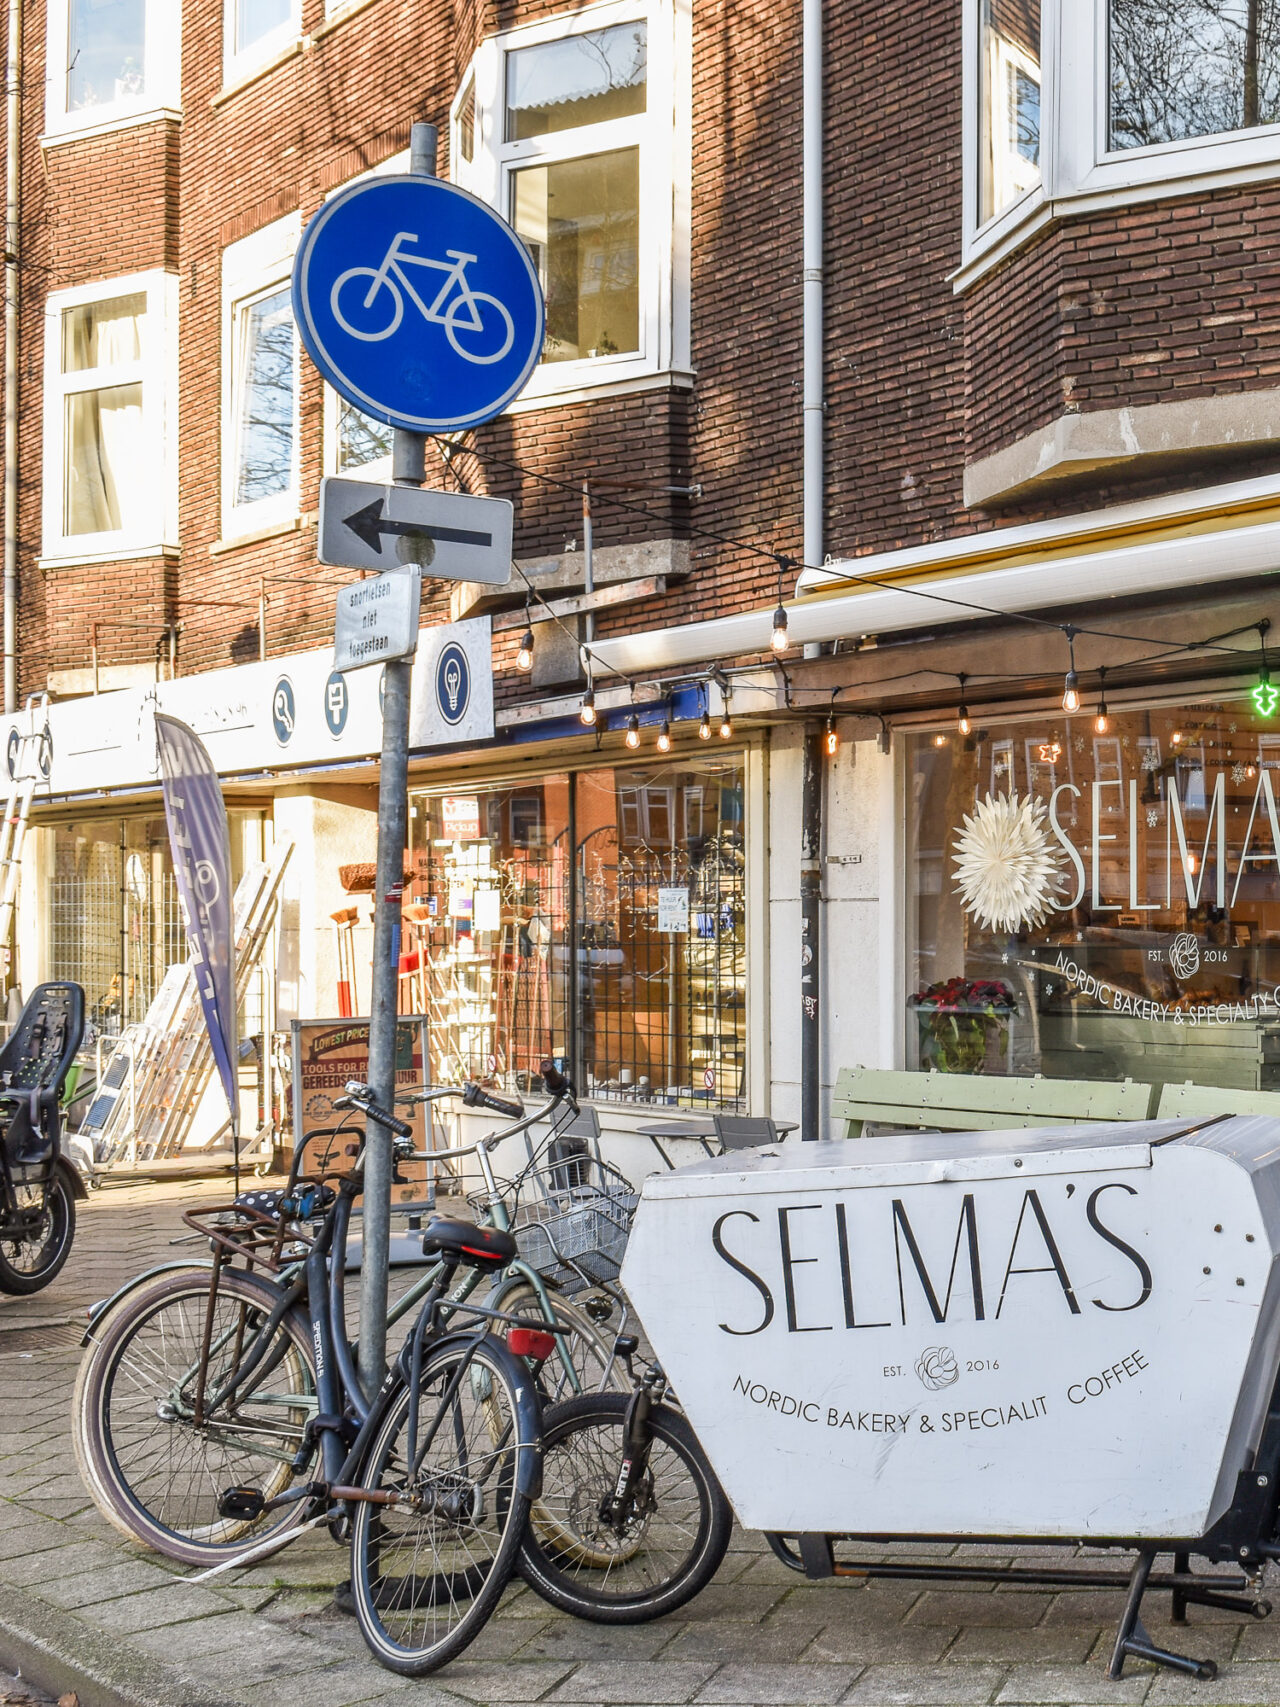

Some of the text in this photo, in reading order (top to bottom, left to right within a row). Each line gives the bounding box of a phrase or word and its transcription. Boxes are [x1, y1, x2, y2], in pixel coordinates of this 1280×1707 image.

[362, 609, 378, 629] niet
[349, 635, 389, 660] toegestaan
[445, 820, 478, 833] Pickup
[1204, 950, 1228, 962] 2016
[1055, 950, 1112, 1006] NORDIC
[1112, 991, 1170, 1023] BAKERY
[1173, 1006, 1185, 1025] &
[1189, 991, 1269, 1026] SPECIALTY
[314, 1031, 346, 1052] LOWEST
[303, 1064, 335, 1074] TOOLS
[337, 1062, 357, 1072] FOR
[303, 1073, 368, 1090] GEREEDSCHA
[712, 1183, 1153, 1335] SELMA'S
[883, 1359, 999, 1377] EST. 2016
[733, 1349, 1149, 1433] NORDIC BAKERY & SPECIALIT COFFEE
